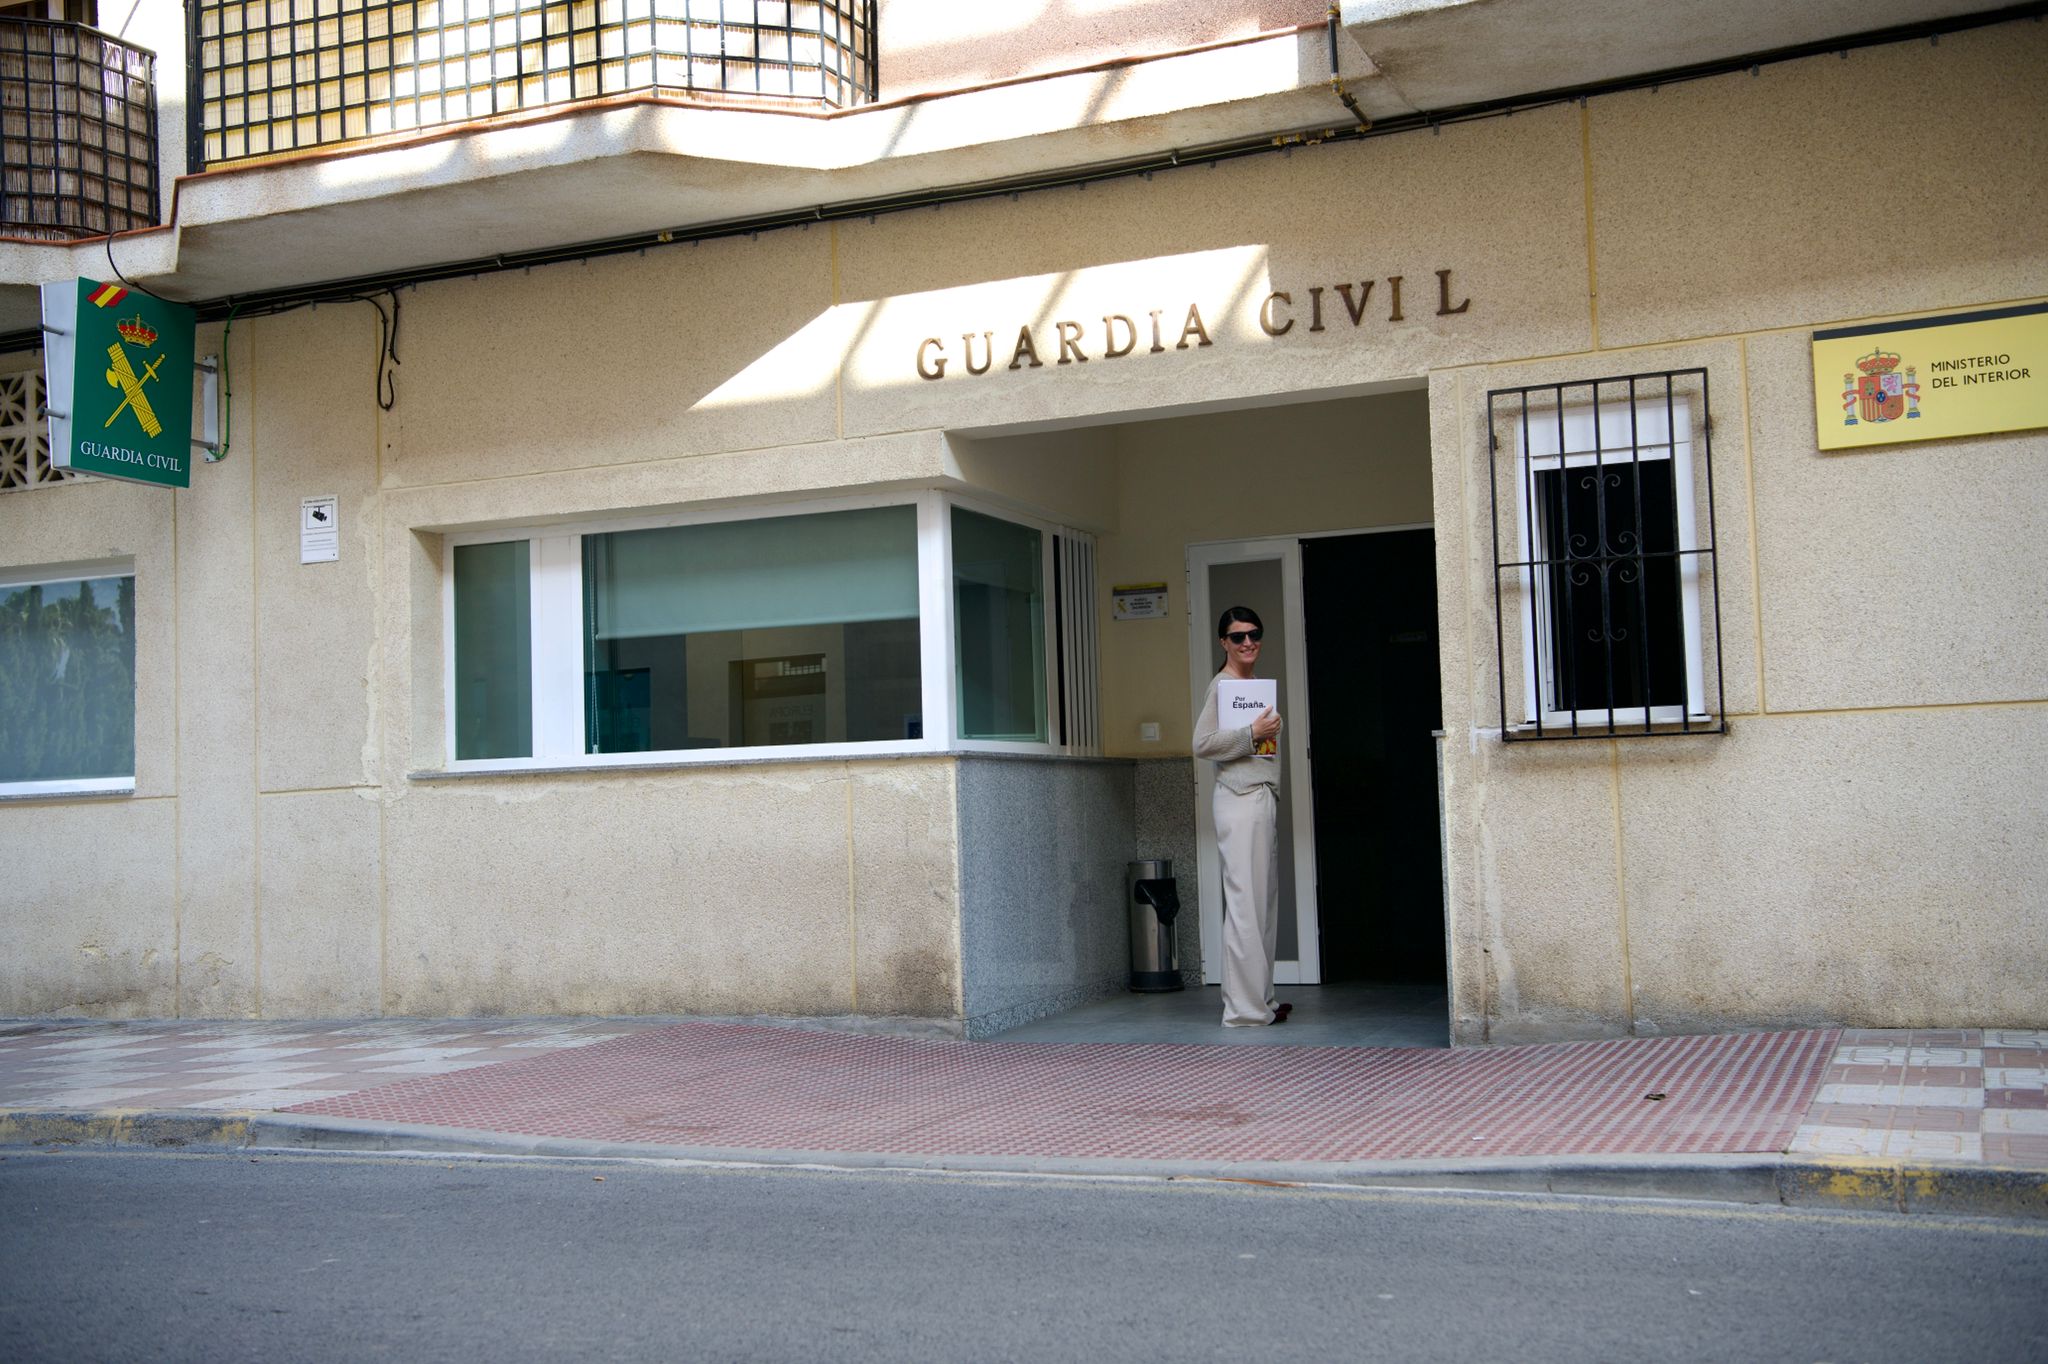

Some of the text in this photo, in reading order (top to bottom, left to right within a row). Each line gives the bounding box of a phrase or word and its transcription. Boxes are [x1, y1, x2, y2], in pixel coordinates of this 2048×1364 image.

[917, 269, 1471, 381] GUARDIA CIVIL
[1931, 354, 2010, 372] MINISTERIO
[1932, 368, 2031, 389] DEL INTERIOR
[80, 441, 182, 472] GUARDIA CIVIL
